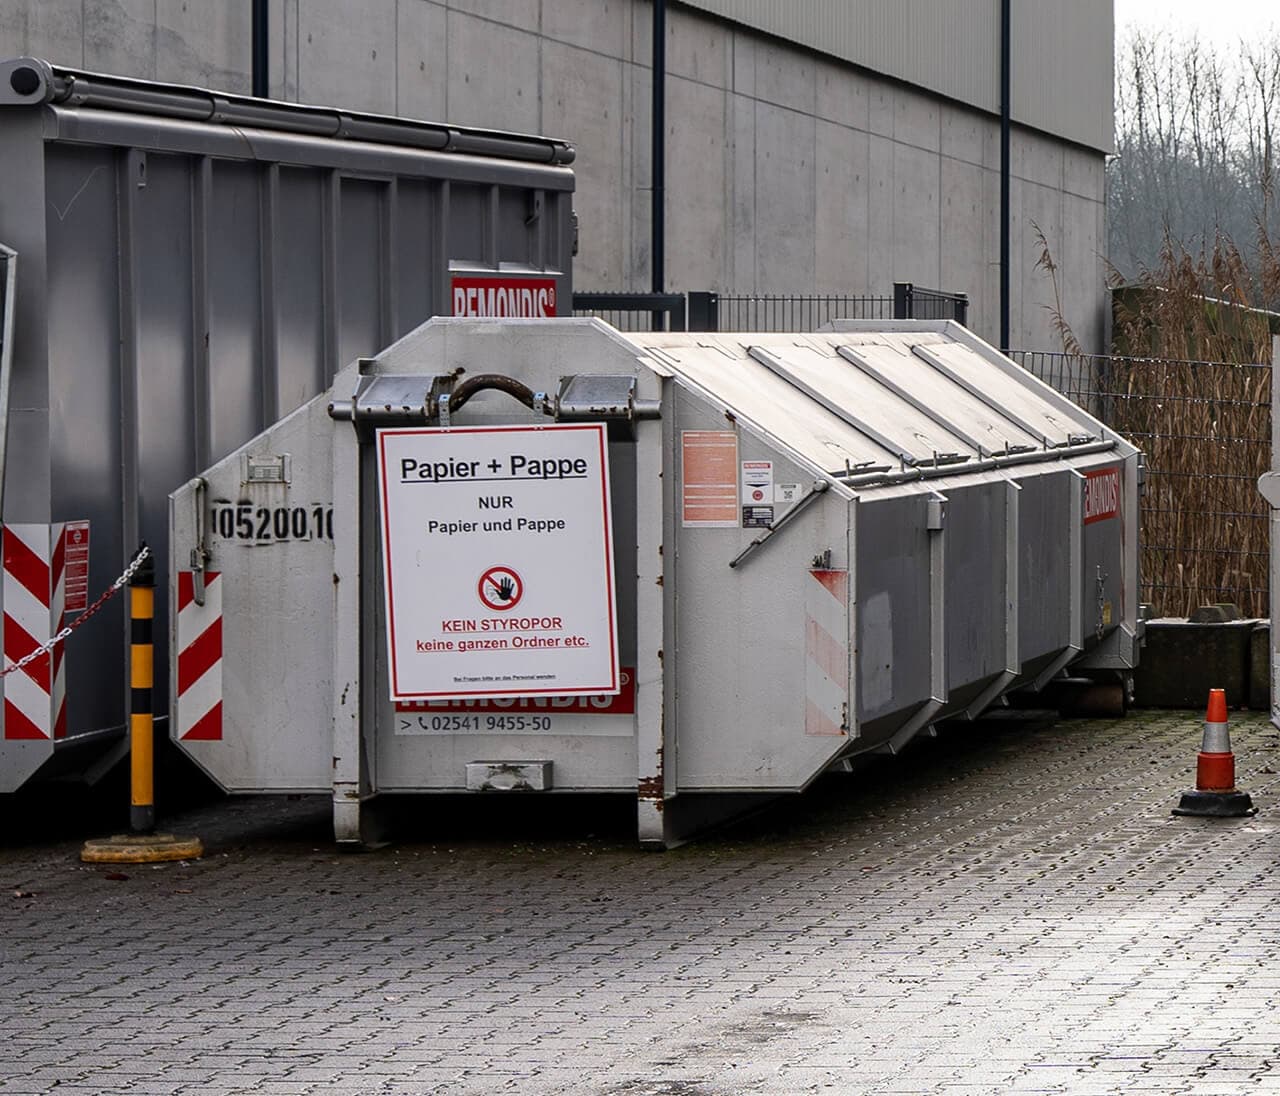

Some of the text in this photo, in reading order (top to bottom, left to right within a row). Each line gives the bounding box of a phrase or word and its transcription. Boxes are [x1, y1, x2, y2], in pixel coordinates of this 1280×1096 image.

[401, 455, 588, 482] Papier + Pappe
[478, 495, 514, 509] NUR
[428, 517, 565, 535] Papier und Pappe
[442, 617, 562, 632] KEIN STYROPOR
[416, 636, 590, 652] keine ganzen Ordner etc.
[432, 716, 552, 731] 02541 9455-50
